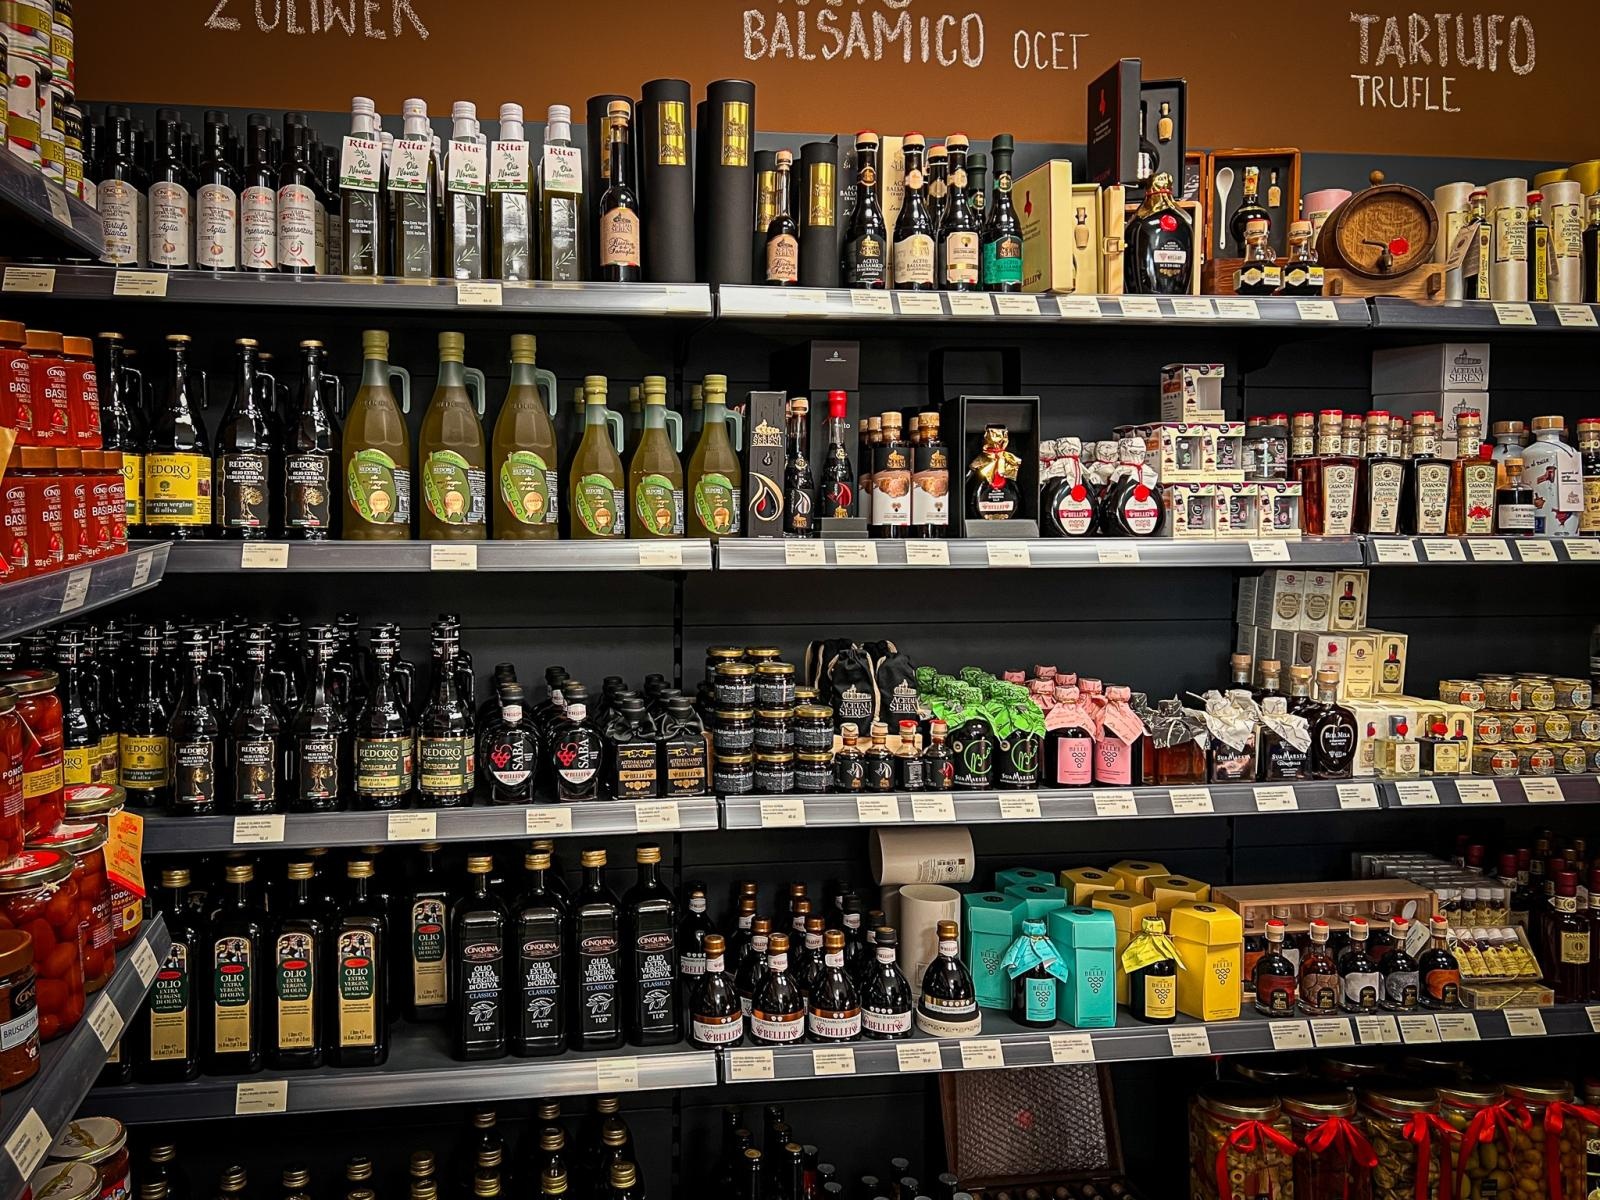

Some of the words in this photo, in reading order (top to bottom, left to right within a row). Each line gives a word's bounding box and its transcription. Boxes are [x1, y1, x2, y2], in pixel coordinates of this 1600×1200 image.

[743, 9, 984, 68] BALSAMICO
[1013, 29, 1090, 70] OCET
[1350, 11, 1536, 76] TARTUFO
[1350, 74, 1461, 112] TRUFLE
[349, 139, 377, 150] Rita
[398, 140, 426, 151] Rita
[454, 142, 481, 153] Rita
[496, 143, 524, 152] Rita
[549, 147, 576, 157] Rita
[358, 159, 371, 168] Olio
[406, 161, 419, 170] Olio
[465, 163, 477, 172] Olio
[506, 161, 519, 170] Olio
[348, 166, 373, 176] Novello
[397, 167, 420, 177] Novello
[456, 169, 479, 179] Novello
[498, 168, 521, 178] Novello
[560, 165, 572, 173] Olio
[552, 170, 574, 179] Novello
[160, 223, 178, 233] Aglio
[206, 225, 227, 235] Aglio
[1452, 366, 1484, 375] ACETAIA
[1449, 372, 1485, 383] SERENI
[229, 461, 263, 472] REDORO
[290, 460, 324, 473] REDORO
[170, 501, 193, 509] vergine
[125, 743, 162, 756] REDORO
[360, 746, 399, 761] REDORO
[423, 746, 462, 760] REDORO
[578, 738, 589, 769] SABA
[512, 739, 524, 771] SABA
[971, 746, 991, 773] Bio
[1018, 745, 1039, 772] Bio
[418, 934, 440, 942] OLIO
[584, 937, 615, 947] CINQUINA
[641, 934, 672, 945] CINQUINA
[467, 944, 499, 955] CINQUINA
[525, 941, 557, 951] CINQUINA
[591, 957, 608, 966] OLIO
[646, 954, 664, 962] OLIO
[532, 961, 550, 969] OLIO
[641, 965, 672, 973] VERGINE
[644, 960, 668, 968] EXTRA
[283, 969, 307, 978] OLIO
[344, 968, 368, 976] OLIO
[529, 967, 553, 975] EXTRA
[584, 969, 616, 977] VERGINE
[649, 971, 671, 979] OLIVA
[220, 973, 244, 983] OLIO
[468, 976, 499, 985] VERGINE
[526, 973, 557, 981] VERGINE
[156, 980, 182, 988] OLIO
[476, 981, 498, 989] OLIVA
[586, 983, 615, 992] CLASSICO
[643, 979, 671, 989] CLASSICO
[469, 990, 498, 999] CLASSICO
[527, 988, 556, 996] CLASSICO
[824, 1024, 852, 1037] BELLEI
[868, 1020, 896, 1032] BELLEI
[712, 1029, 739, 1042] BELLEI
[763, 1028, 792, 1040] BELLEI
